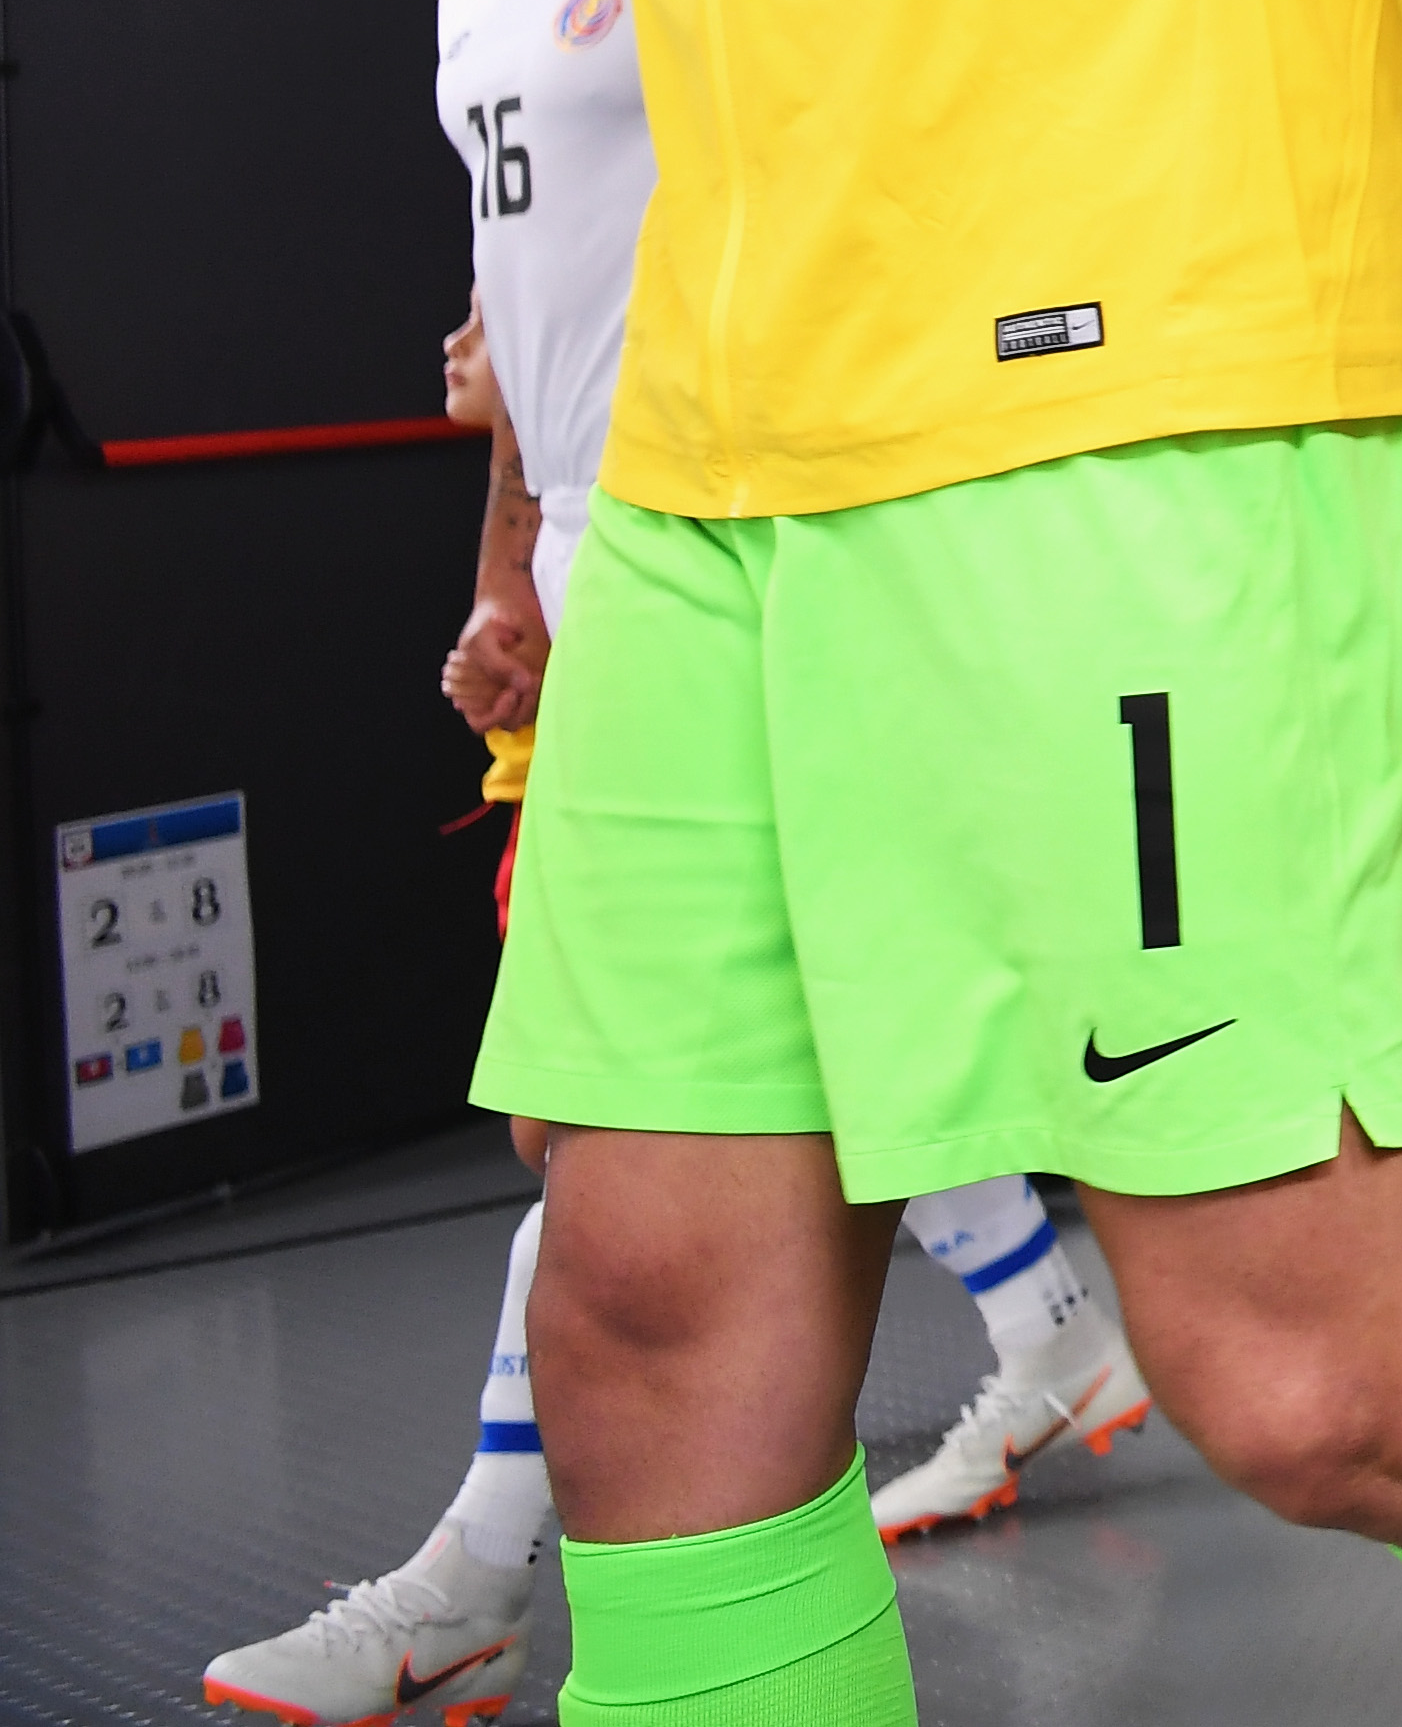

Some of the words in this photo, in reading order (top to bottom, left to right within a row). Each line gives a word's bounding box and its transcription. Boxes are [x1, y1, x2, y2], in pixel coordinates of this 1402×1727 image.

[467, 96, 532, 219] 16
[1119, 692, 1182, 950] 1
[91, 898, 121, 949] 2
[192, 877, 220, 926] 8
[104, 992, 128, 1033] 2
